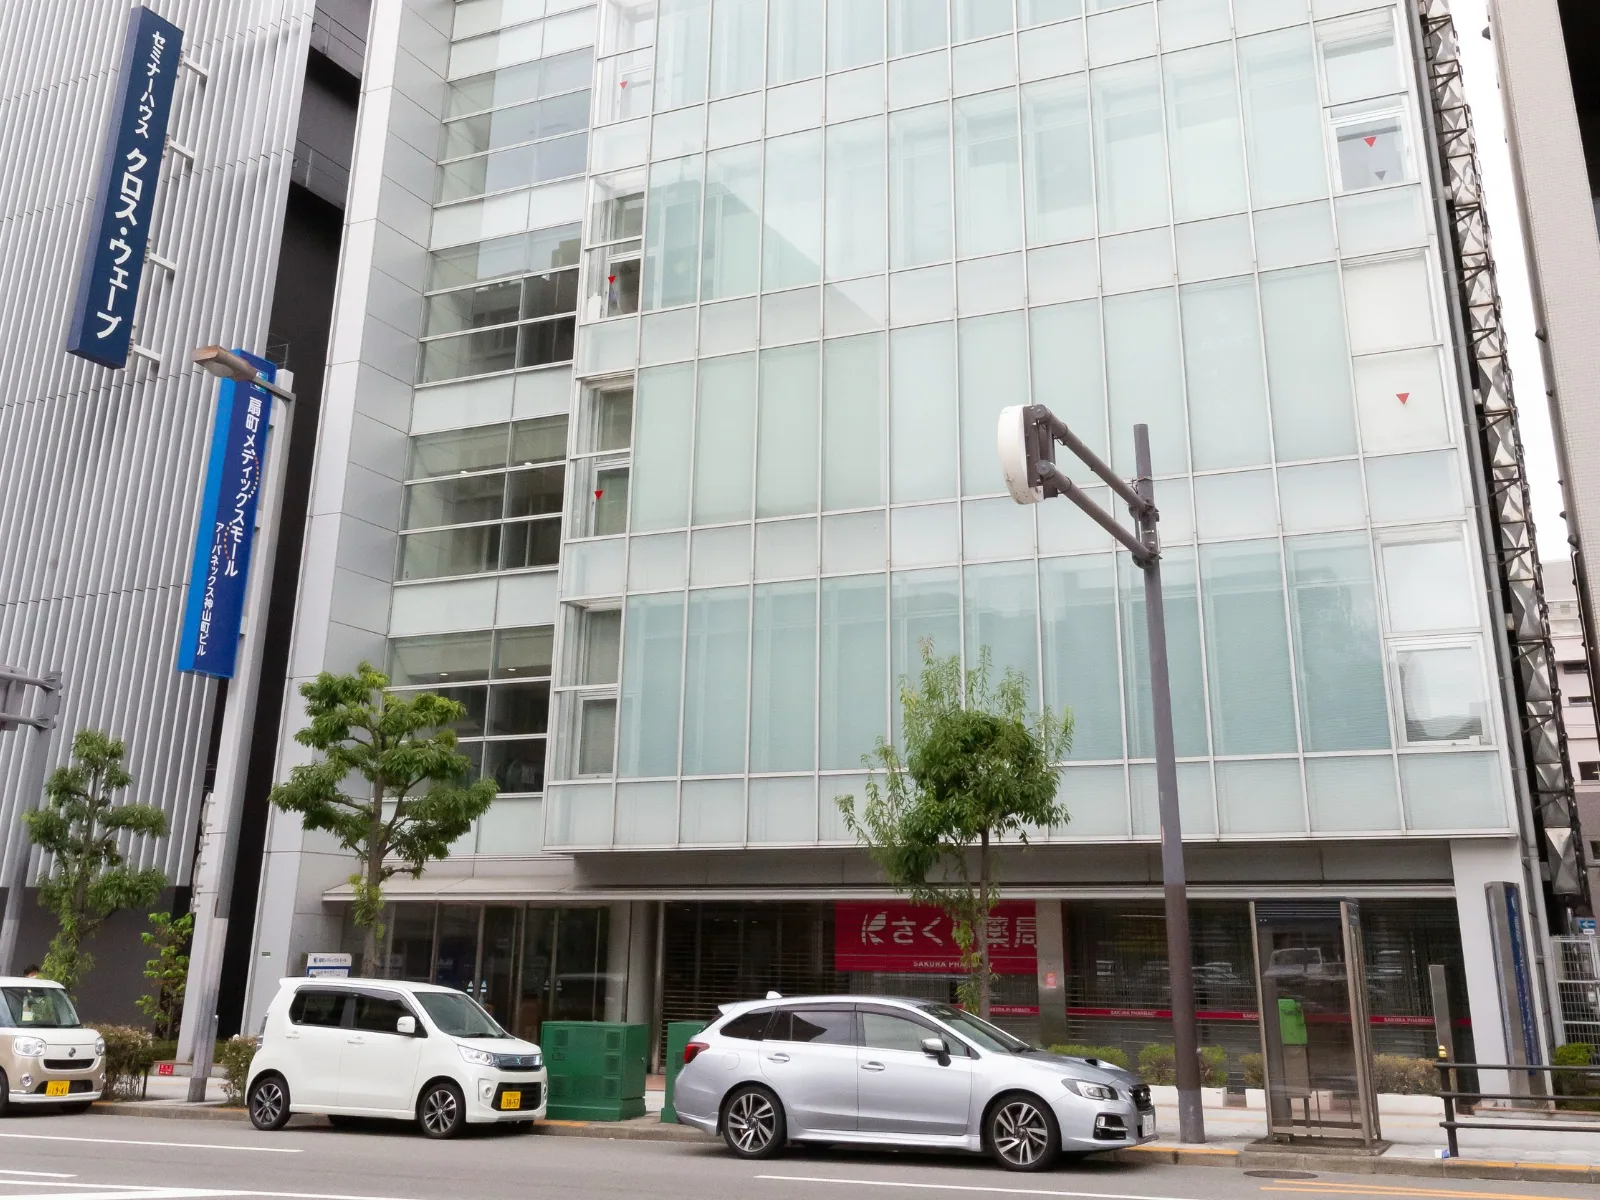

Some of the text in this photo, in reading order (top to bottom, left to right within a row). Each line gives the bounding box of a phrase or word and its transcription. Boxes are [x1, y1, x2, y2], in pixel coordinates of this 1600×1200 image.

[135, 30, 165, 139] セミナーハウス
[224, 396, 262, 577] 扇町メディックスモール
